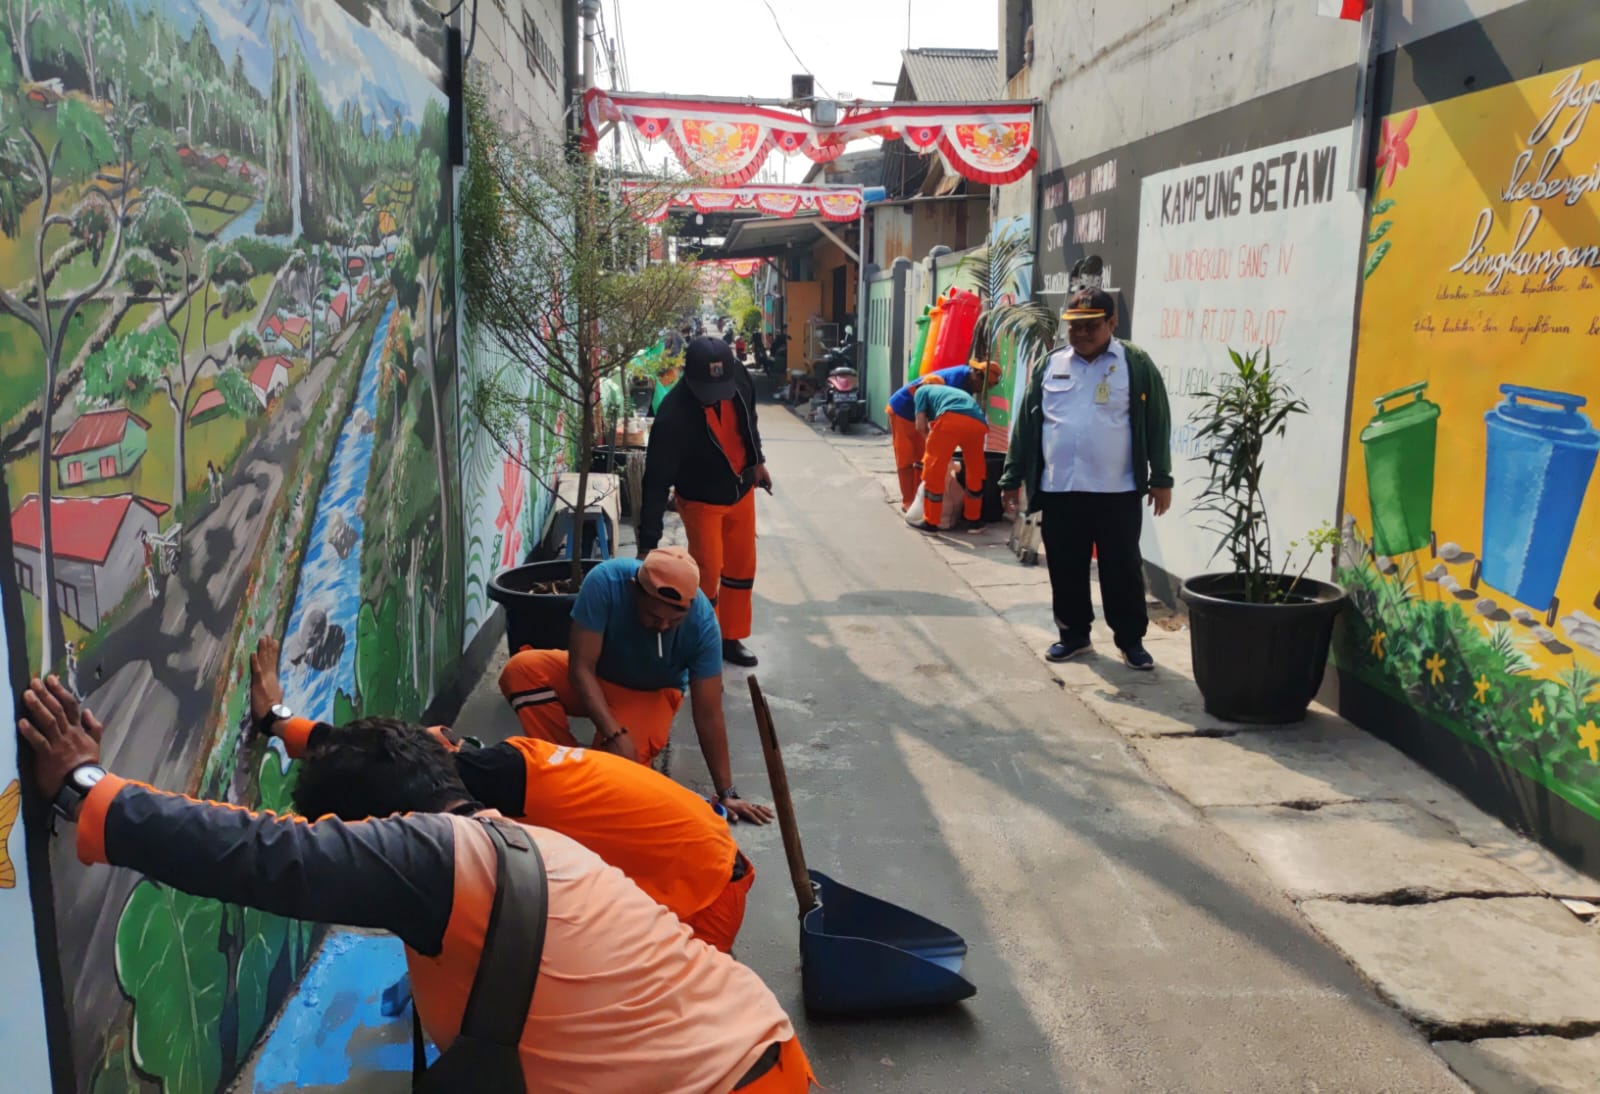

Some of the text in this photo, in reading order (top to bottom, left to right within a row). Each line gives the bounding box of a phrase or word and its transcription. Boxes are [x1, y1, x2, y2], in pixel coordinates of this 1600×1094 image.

[1161, 165, 1244, 227] KAMPUNG
[1250, 146, 1337, 214] BETAWI
[1239, 243, 1269, 278] GANG
